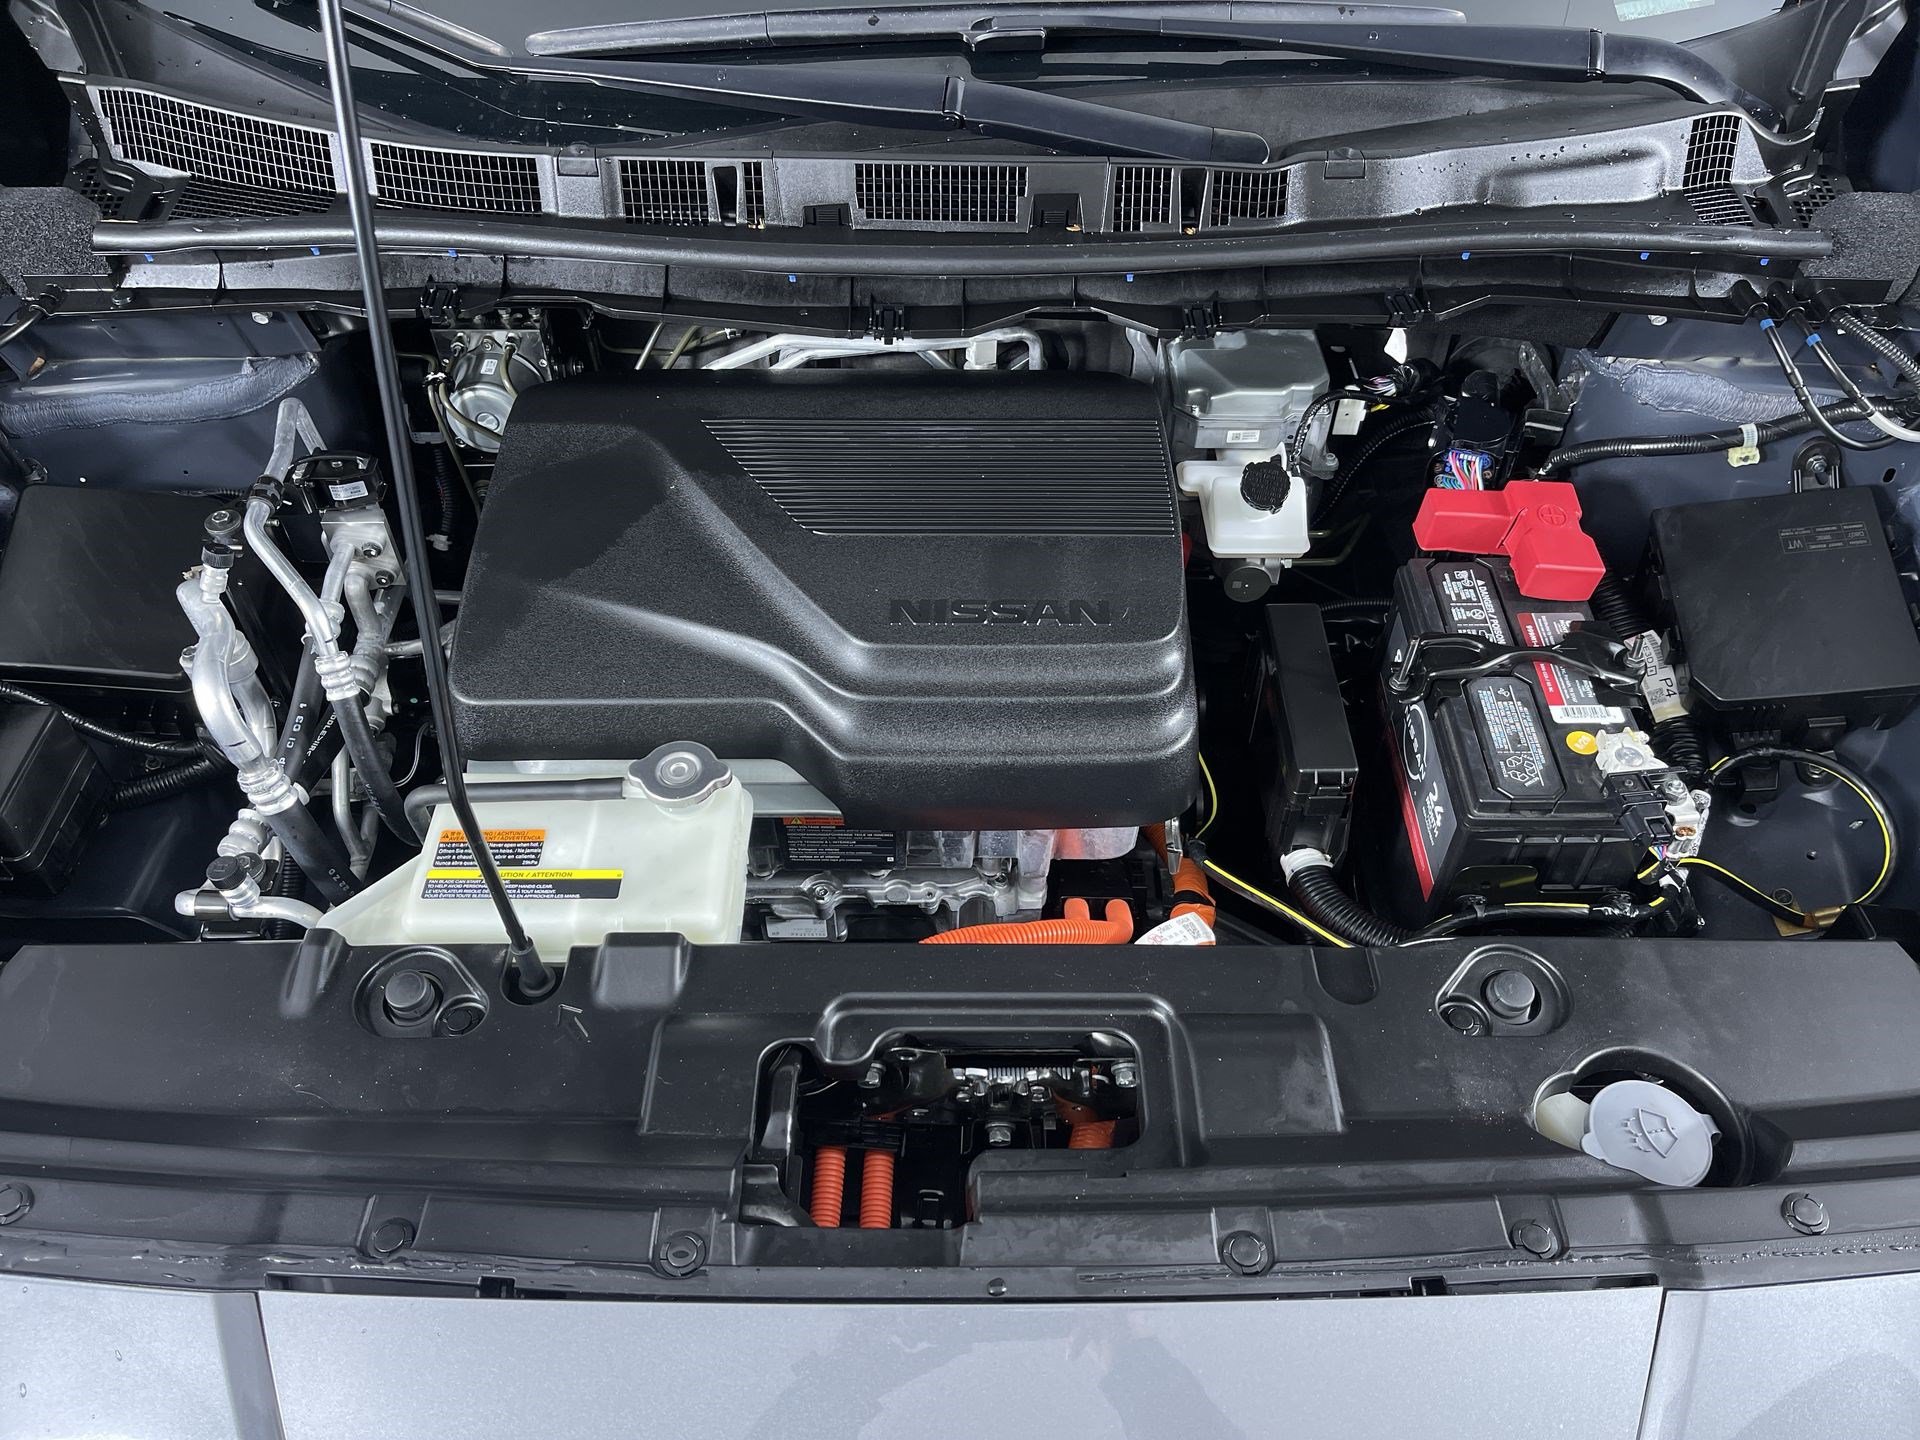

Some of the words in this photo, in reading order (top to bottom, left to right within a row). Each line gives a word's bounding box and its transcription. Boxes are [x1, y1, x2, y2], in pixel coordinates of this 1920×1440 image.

[890, 599, 1111, 625] NISSAN
[1479, 586, 1495, 613] DANGER
[1659, 678, 1678, 698] P4
[1429, 782, 1444, 827] 24
